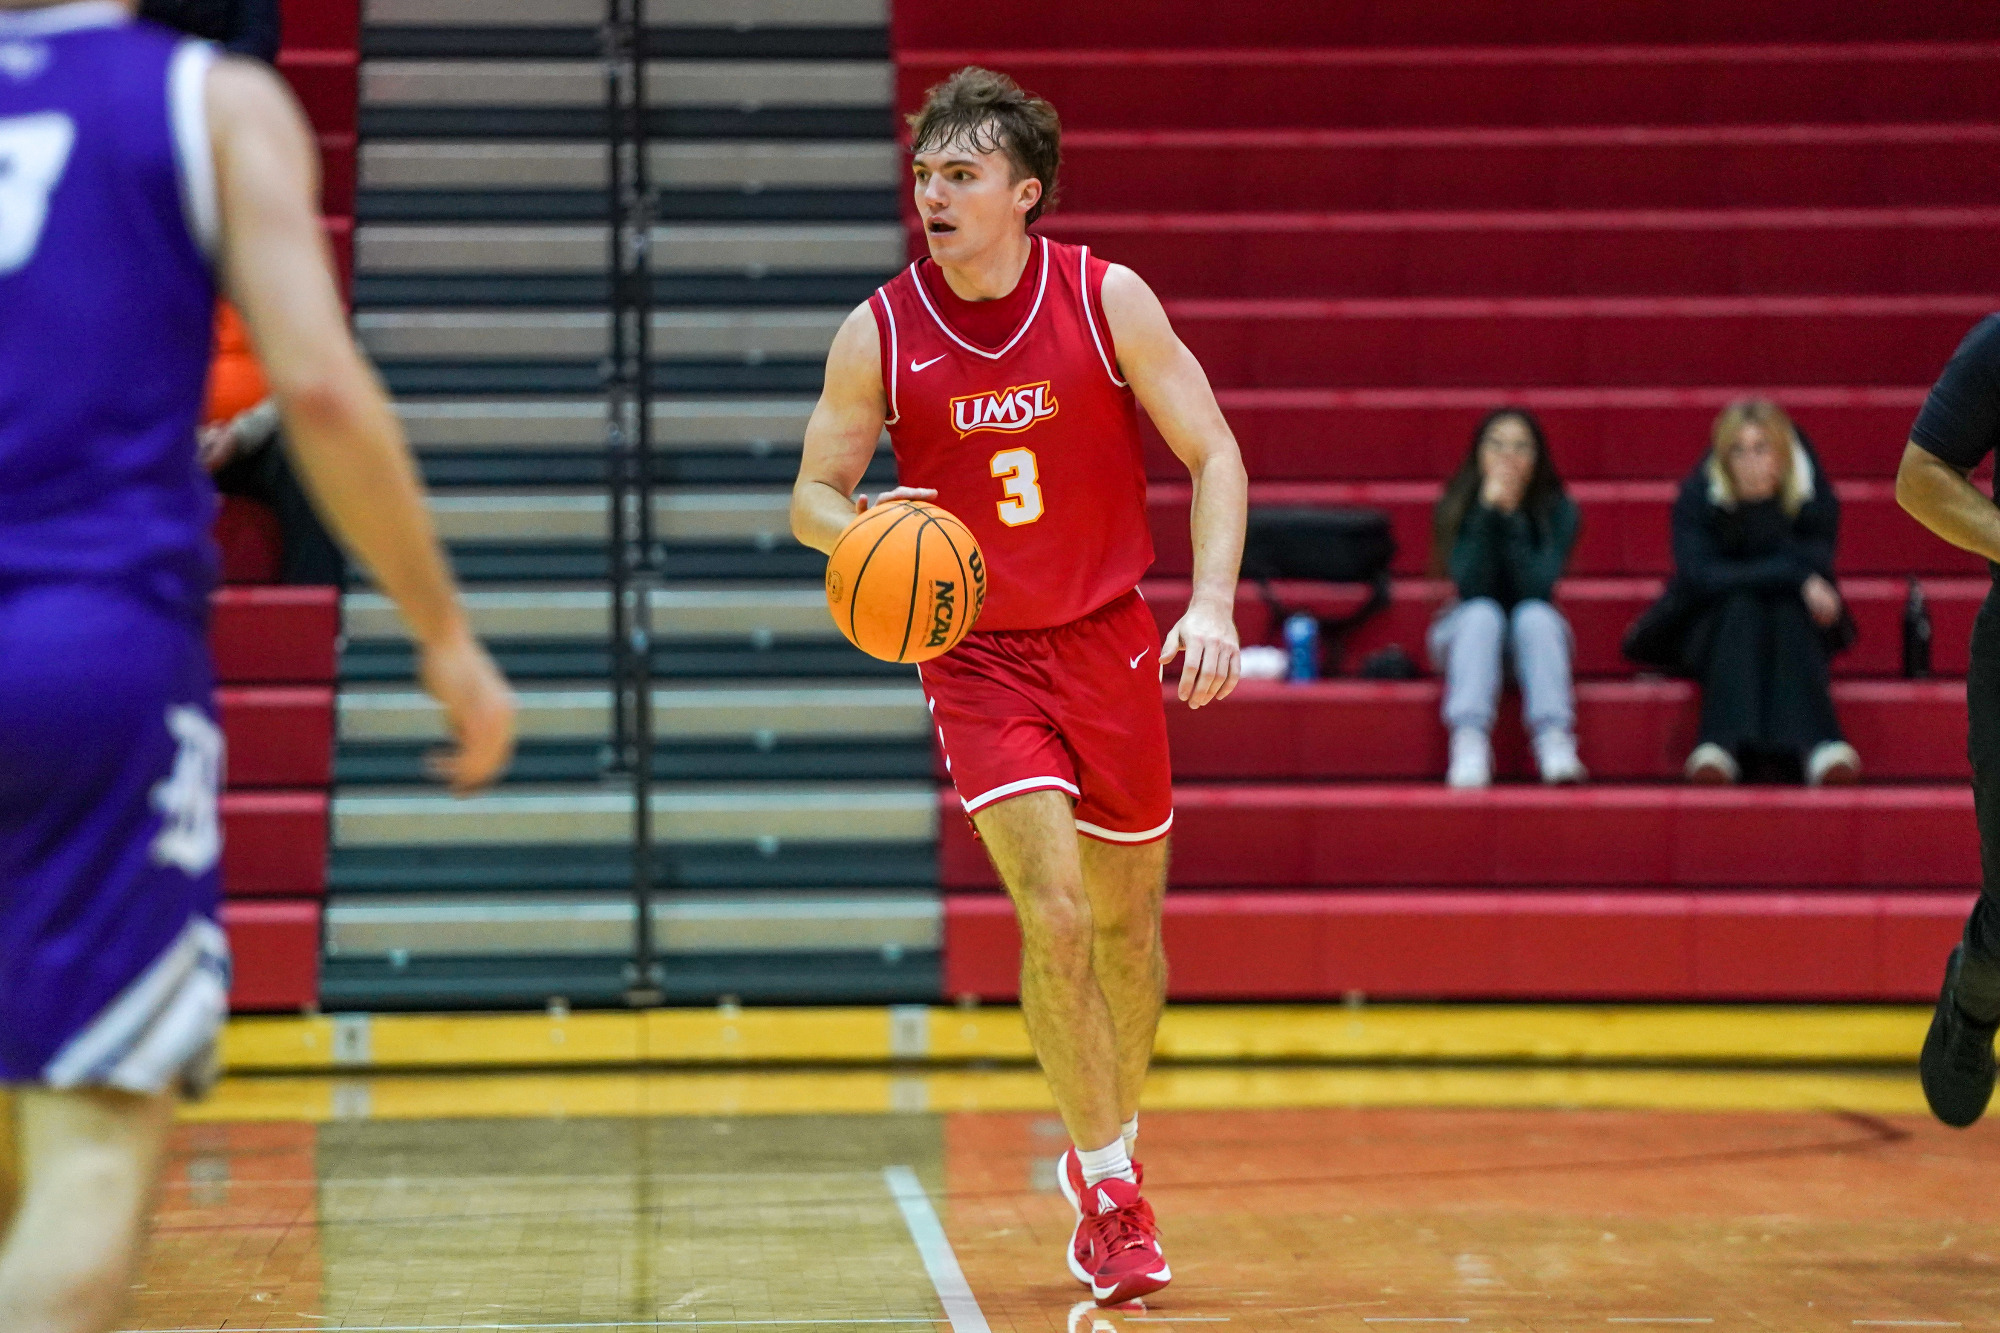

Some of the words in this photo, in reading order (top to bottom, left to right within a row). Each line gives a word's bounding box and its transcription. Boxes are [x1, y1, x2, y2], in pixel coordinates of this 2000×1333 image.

[953, 383, 1057, 433] UMSL
[990, 446, 1044, 527] 3
[925, 579, 954, 648] NCAA
